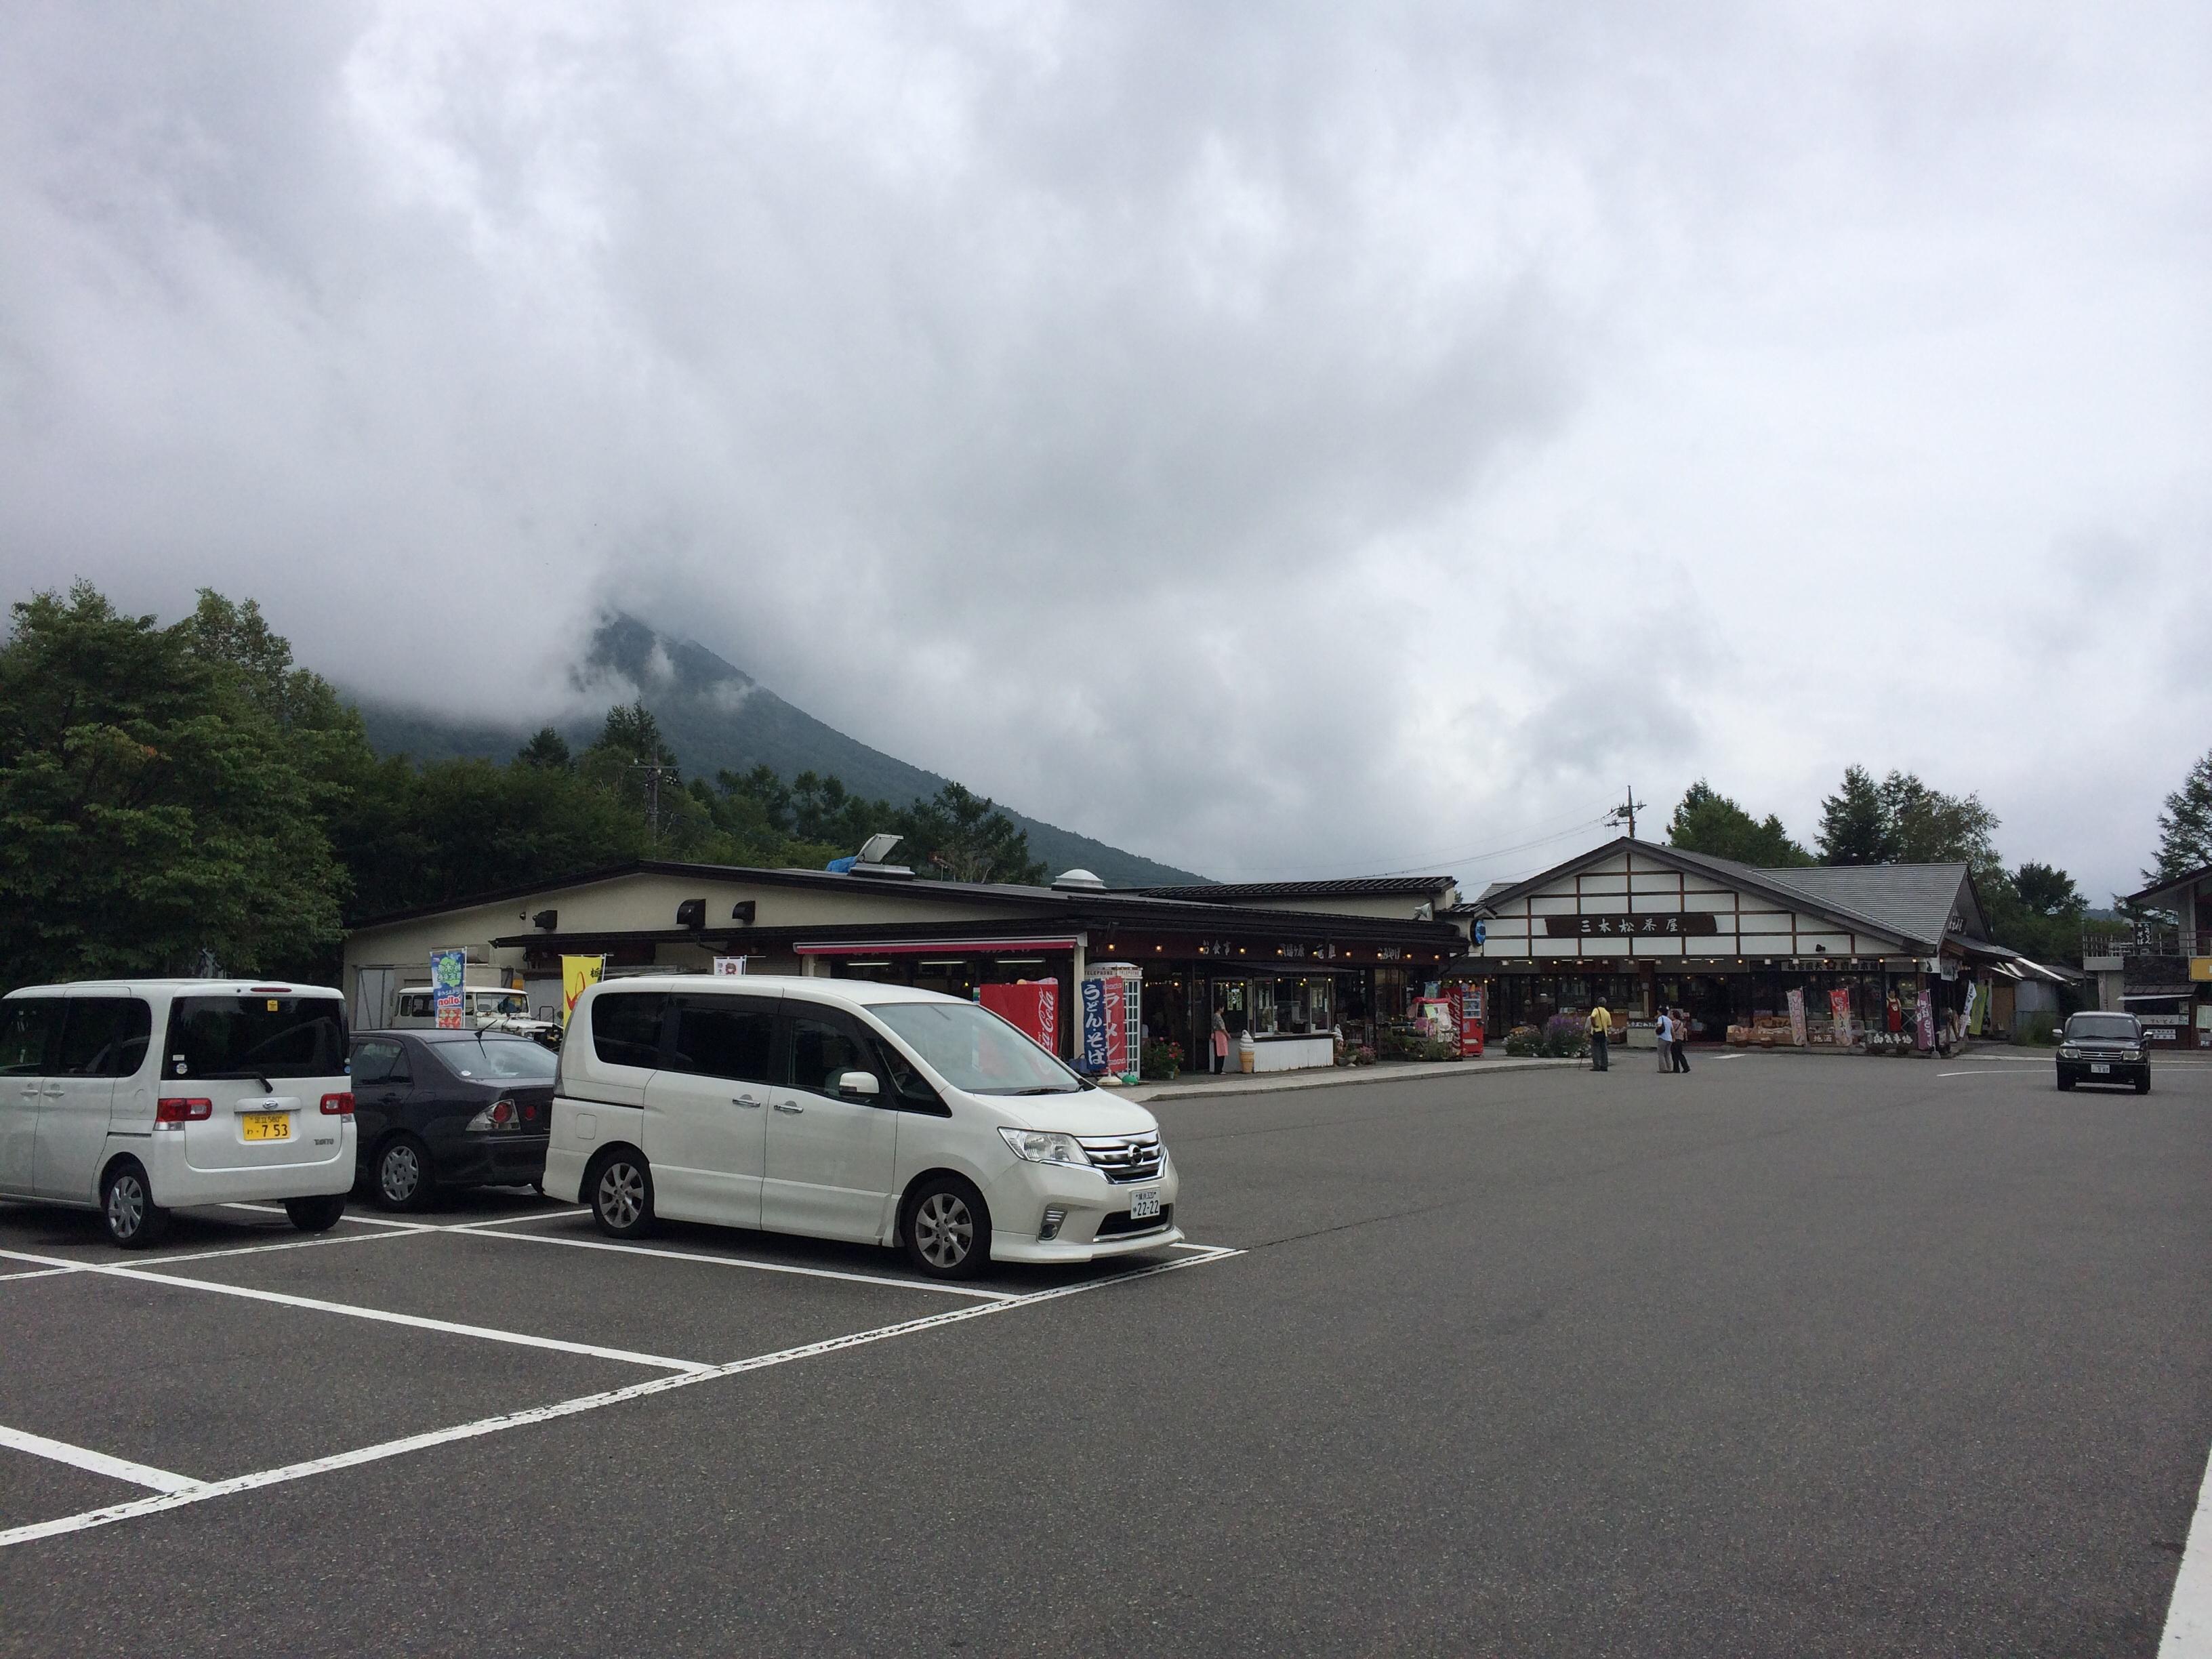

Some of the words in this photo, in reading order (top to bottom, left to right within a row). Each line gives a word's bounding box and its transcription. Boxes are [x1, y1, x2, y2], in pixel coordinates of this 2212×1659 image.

[1580, 918, 1679, 933] 三本松茶屋
[1137, 1200, 1159, 1216] 22-22
